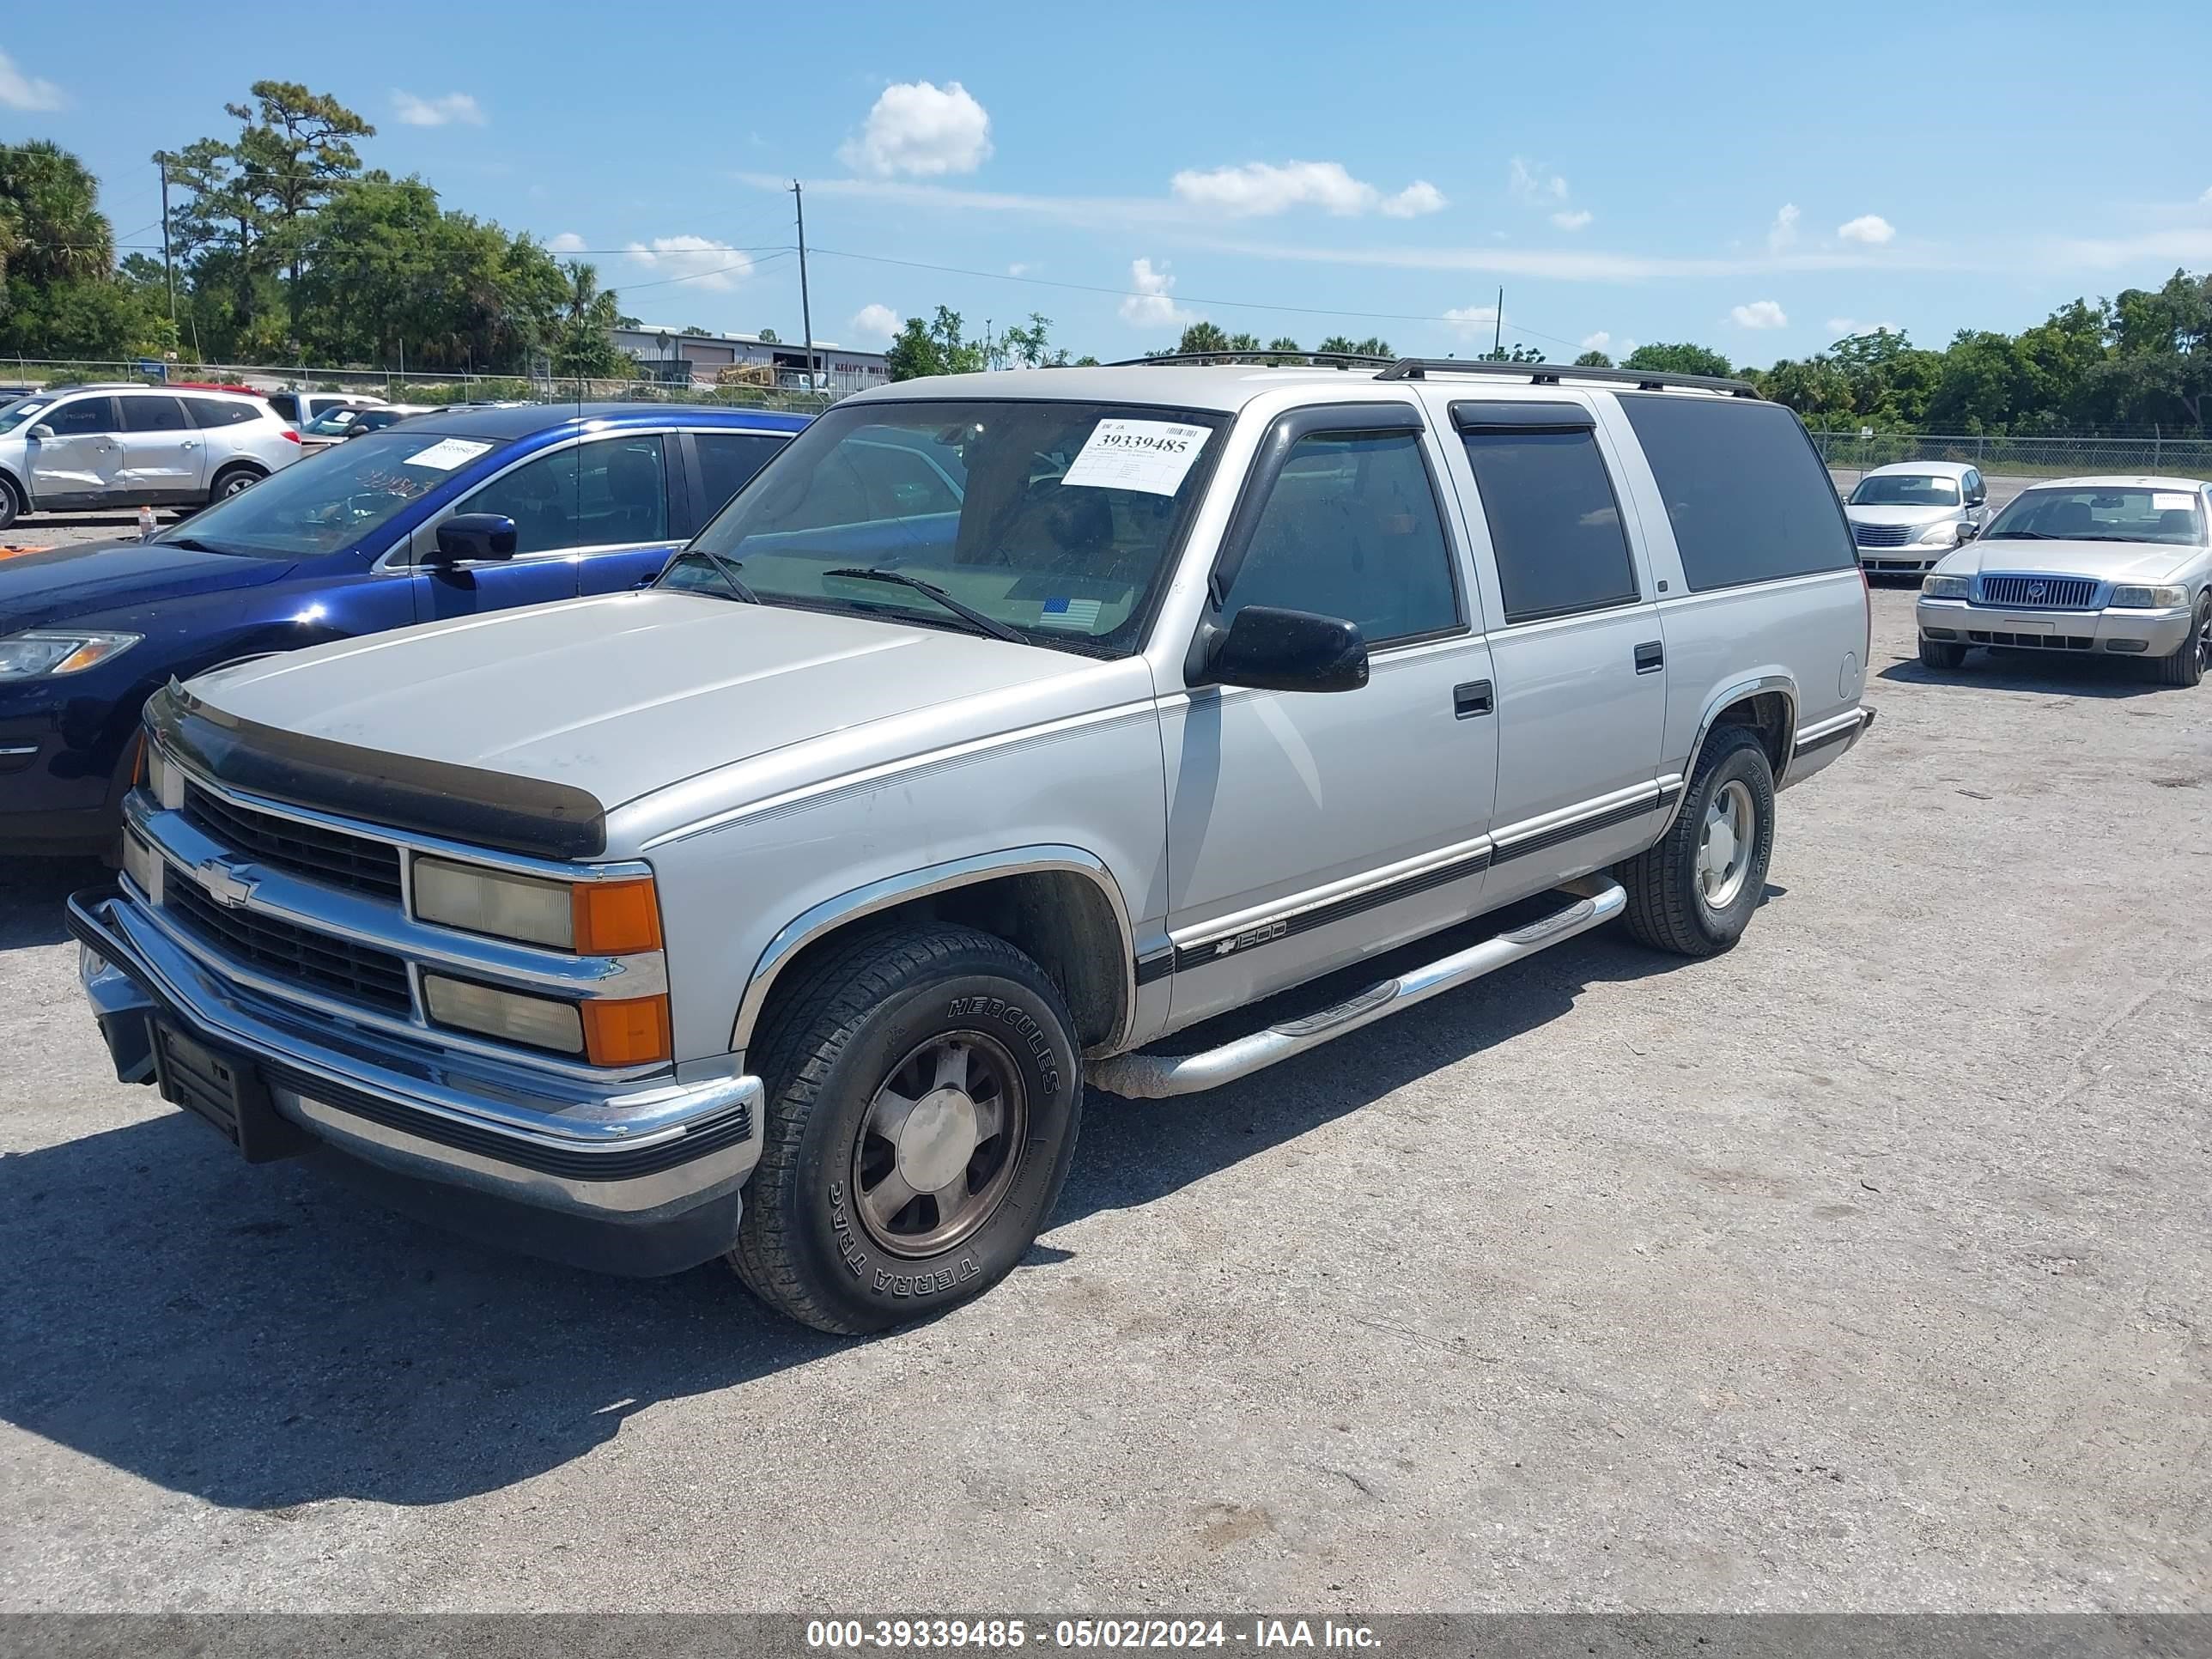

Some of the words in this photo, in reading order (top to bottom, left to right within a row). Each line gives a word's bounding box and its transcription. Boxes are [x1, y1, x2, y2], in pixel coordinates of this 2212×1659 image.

[836, 362, 864, 373] KELLY'S
[1097, 434, 1188, 453] 39339485
[1236, 921, 1287, 950] 1500
[948, 996, 1060, 1094] HERCULES
[830, 1180, 868, 1277] TRAC
[872, 1257, 981, 1297] TERRA
